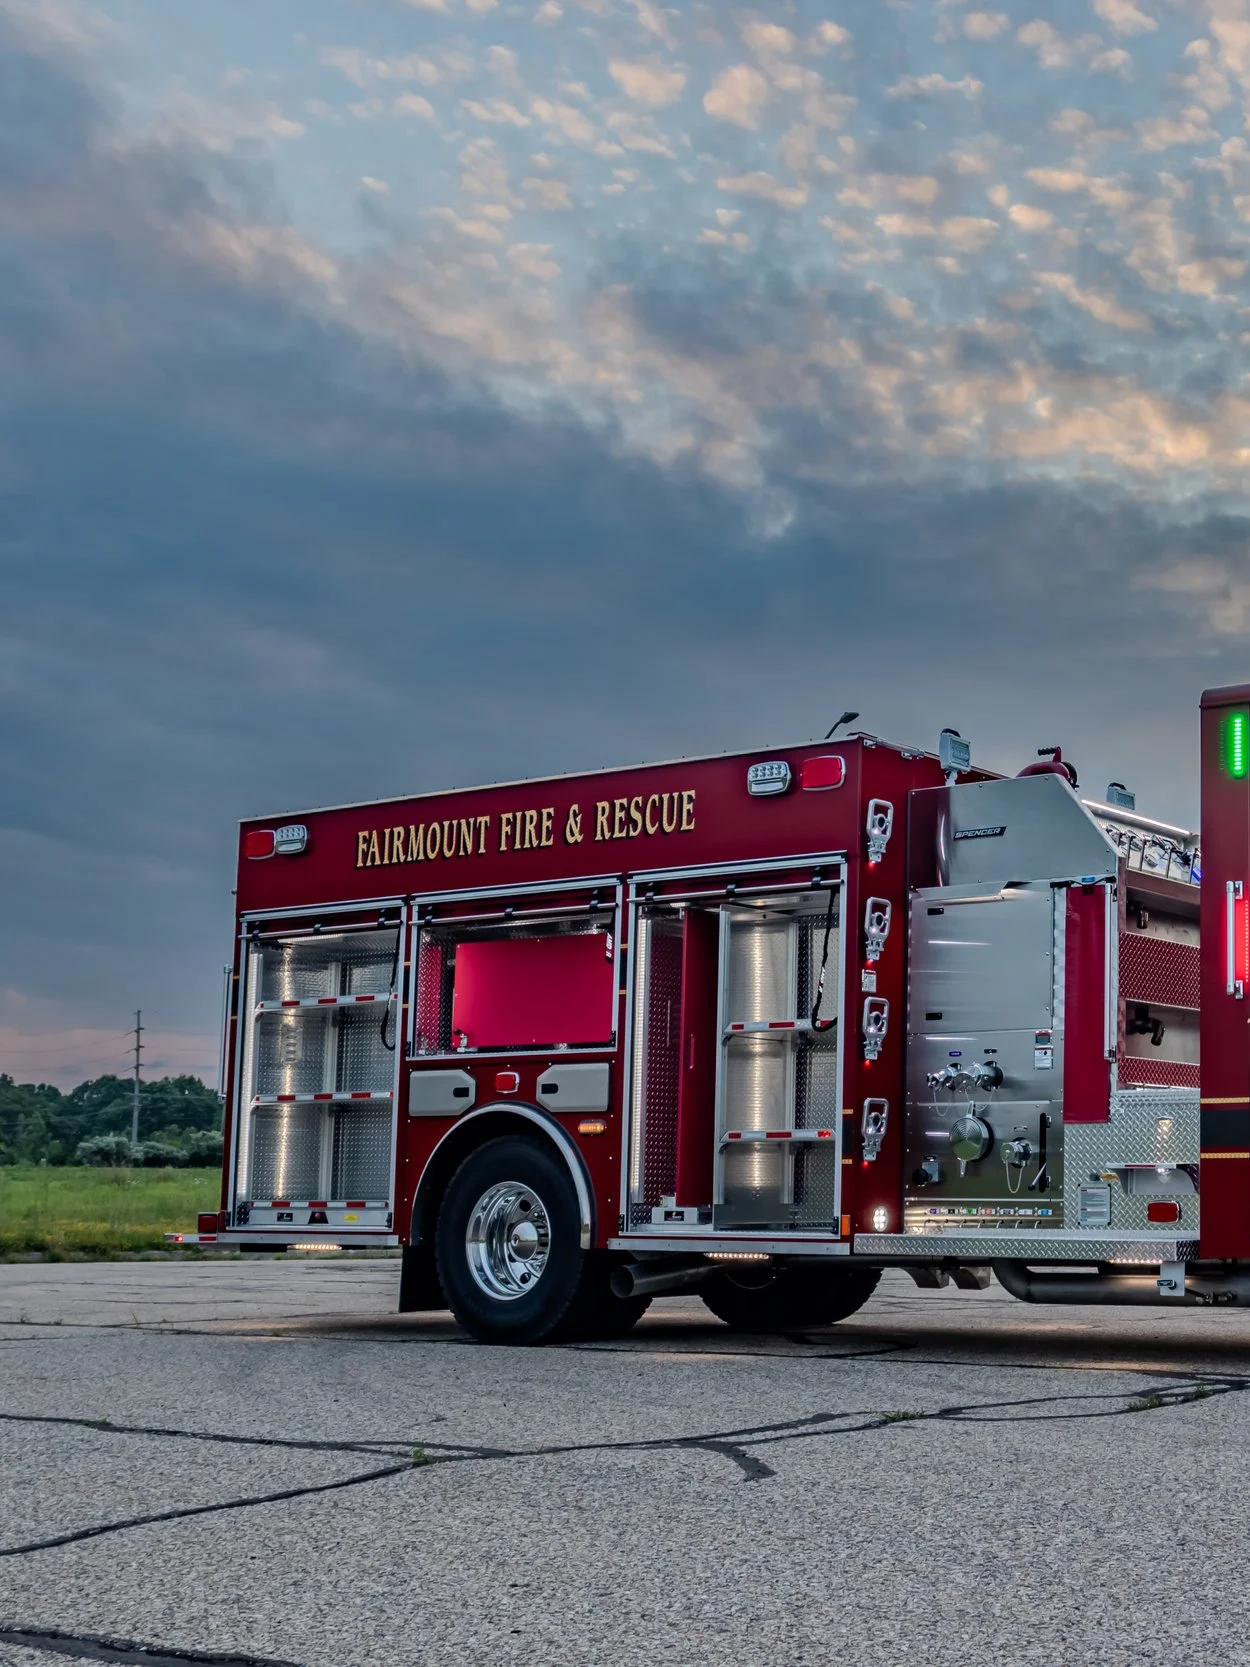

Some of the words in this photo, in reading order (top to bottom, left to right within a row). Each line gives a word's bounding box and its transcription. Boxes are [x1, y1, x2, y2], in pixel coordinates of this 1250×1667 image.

[356, 815, 490, 868] FAIRMOUNT
[500, 807, 555, 852] FIRE
[565, 803, 584, 844] &
[594, 789, 697, 842] RESCUE
[954, 827, 1002, 839] SPENCER
